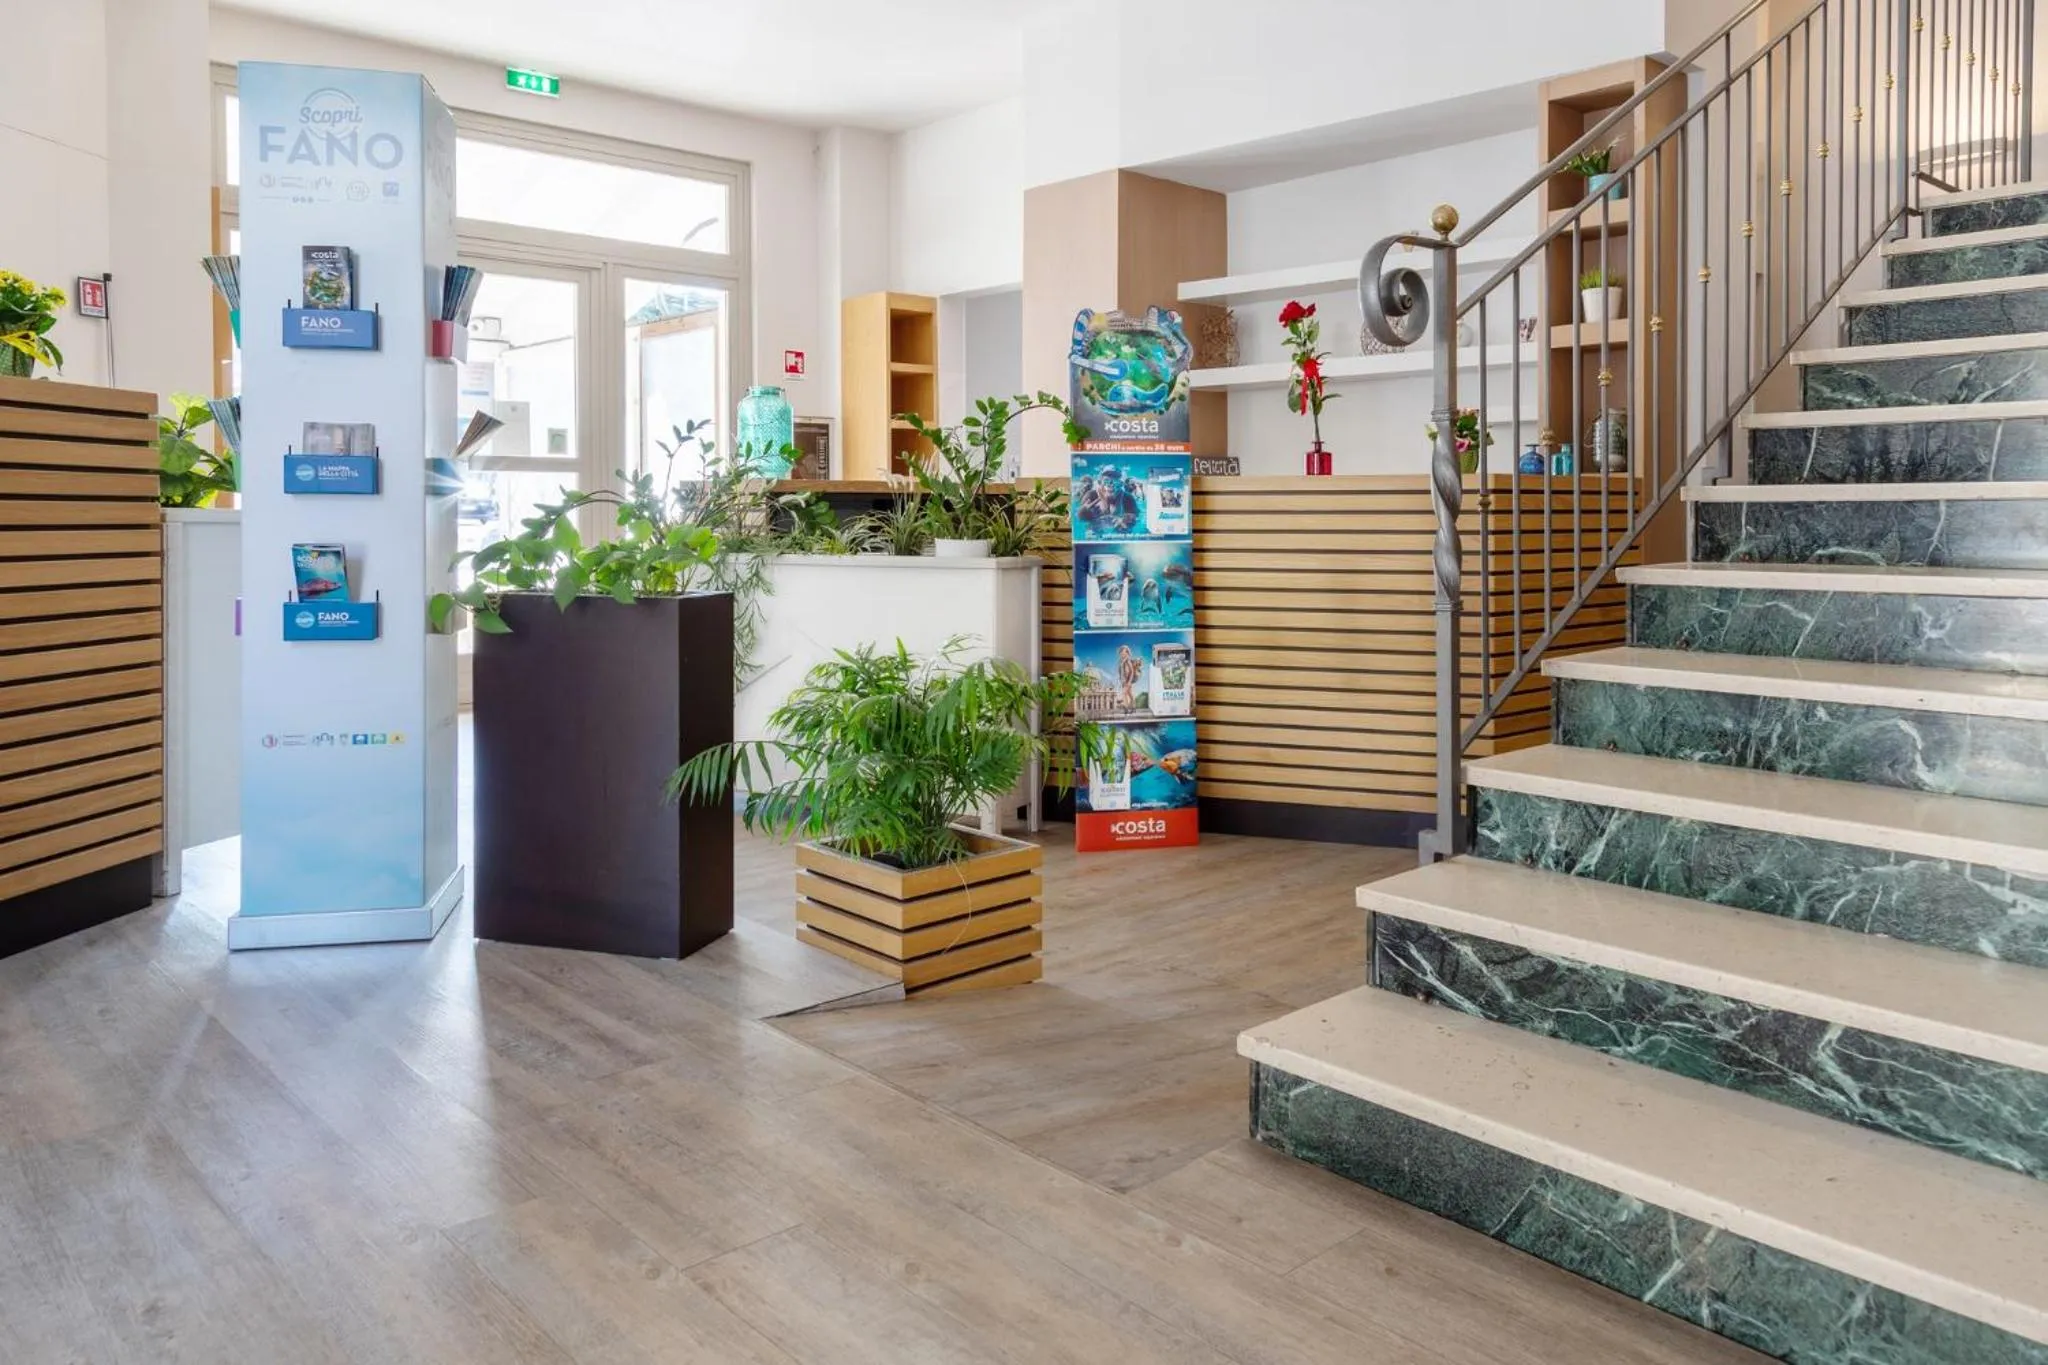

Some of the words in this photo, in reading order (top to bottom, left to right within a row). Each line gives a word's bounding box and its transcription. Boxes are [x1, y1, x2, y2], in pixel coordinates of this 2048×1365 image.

[299, 106, 363, 127] Scopri
[258, 125, 404, 170] FANO
[301, 316, 341, 329] FANO
[1109, 418, 1159, 433] costa
[1086, 442, 1121, 450] PARCHI
[318, 611, 349, 621] FANO
[1115, 817, 1166, 835] costa
